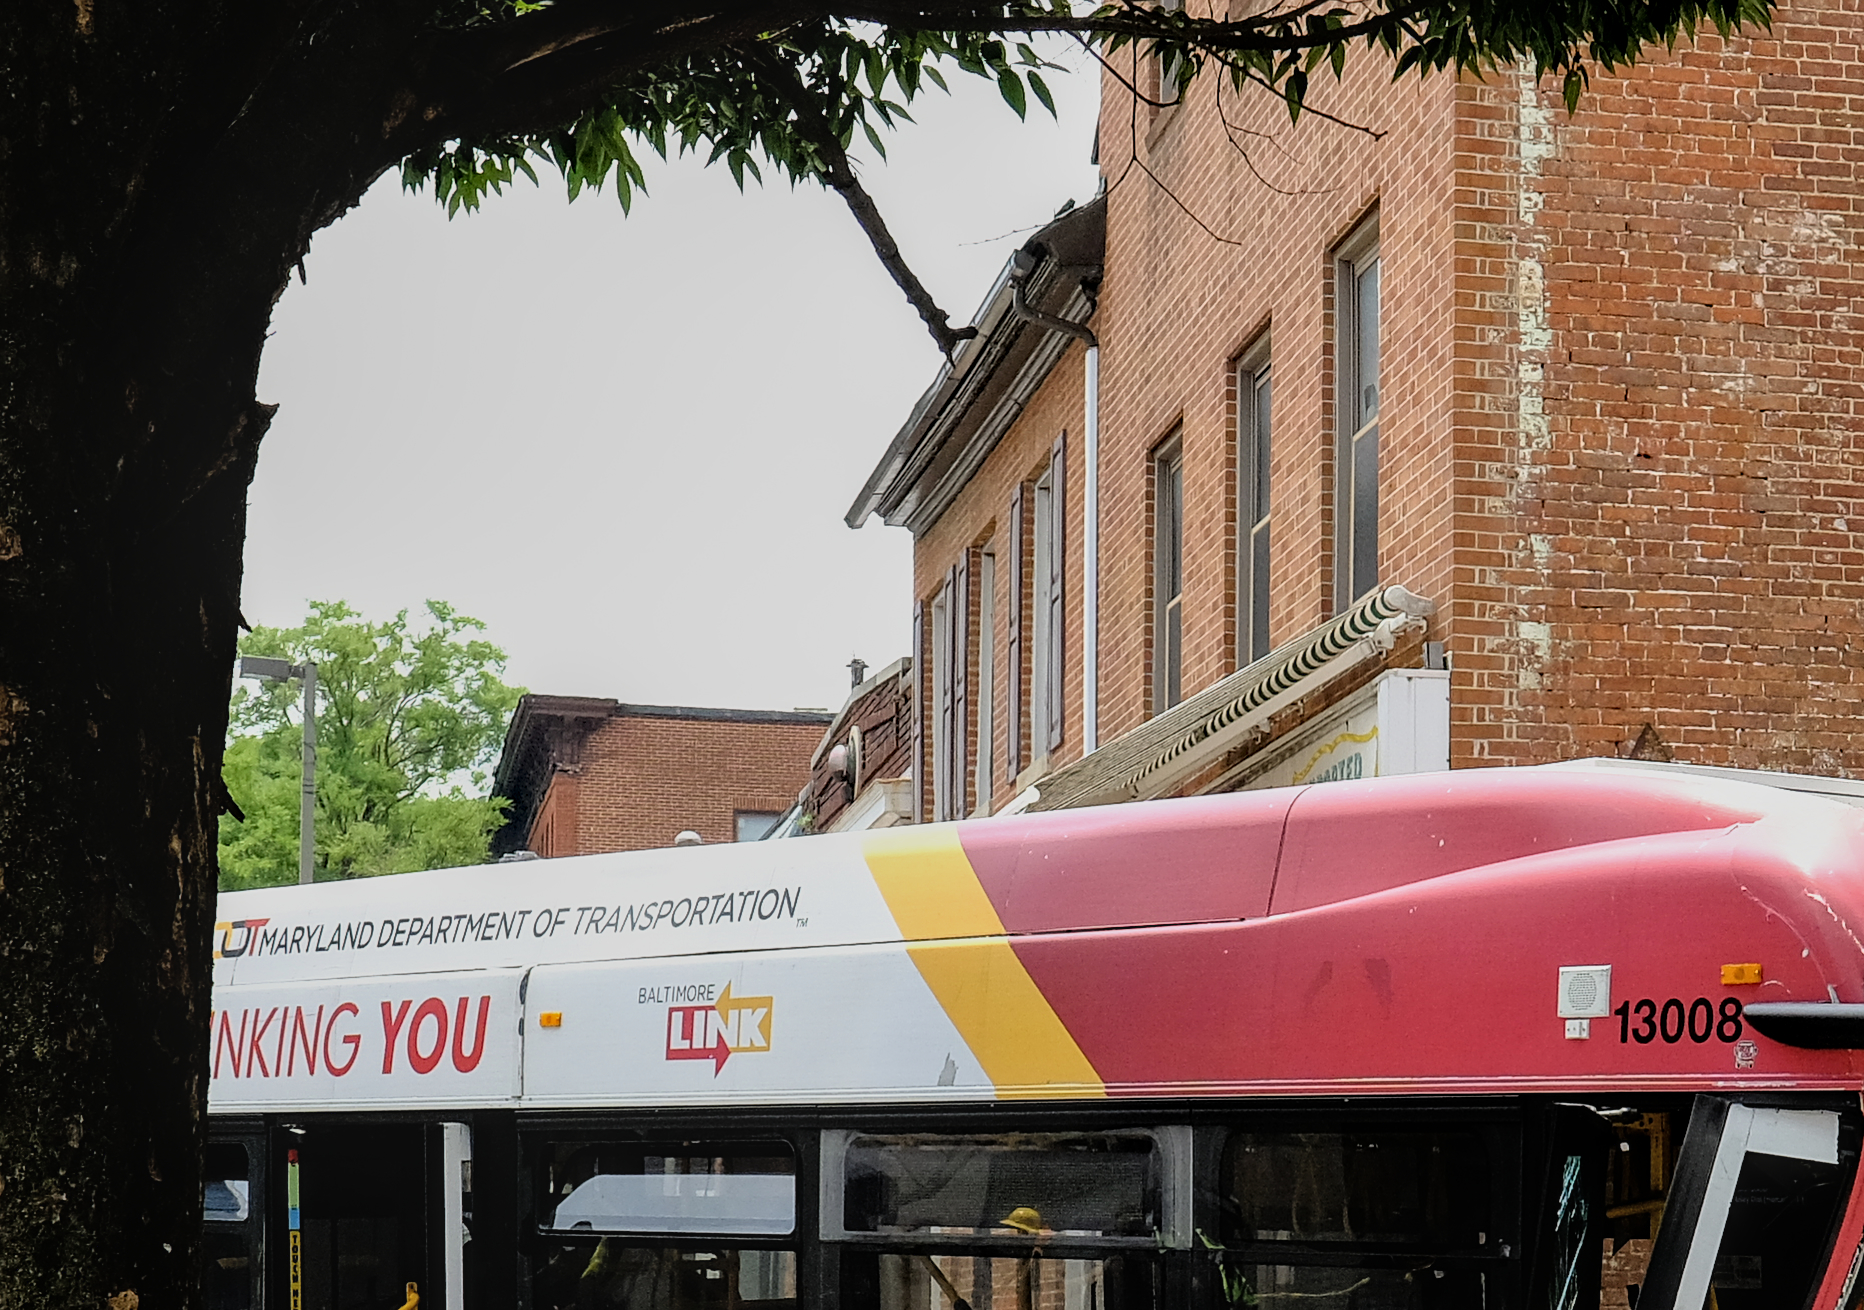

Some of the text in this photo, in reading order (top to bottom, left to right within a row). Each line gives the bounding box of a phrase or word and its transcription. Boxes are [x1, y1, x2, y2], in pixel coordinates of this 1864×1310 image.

[258, 920, 375, 957] MARYLAND
[376, 909, 533, 948] DEPARTMENT
[532, 907, 571, 938] OF
[573, 886, 802, 936] TRANSPORTATION
[637, 983, 716, 1005] BALTIMORE
[210, 994, 491, 1080] NKING YOU
[669, 1006, 768, 1051] LINK
[1613, 996, 1744, 1045] 13008
[291, 1234, 299, 1284] TOUCH
